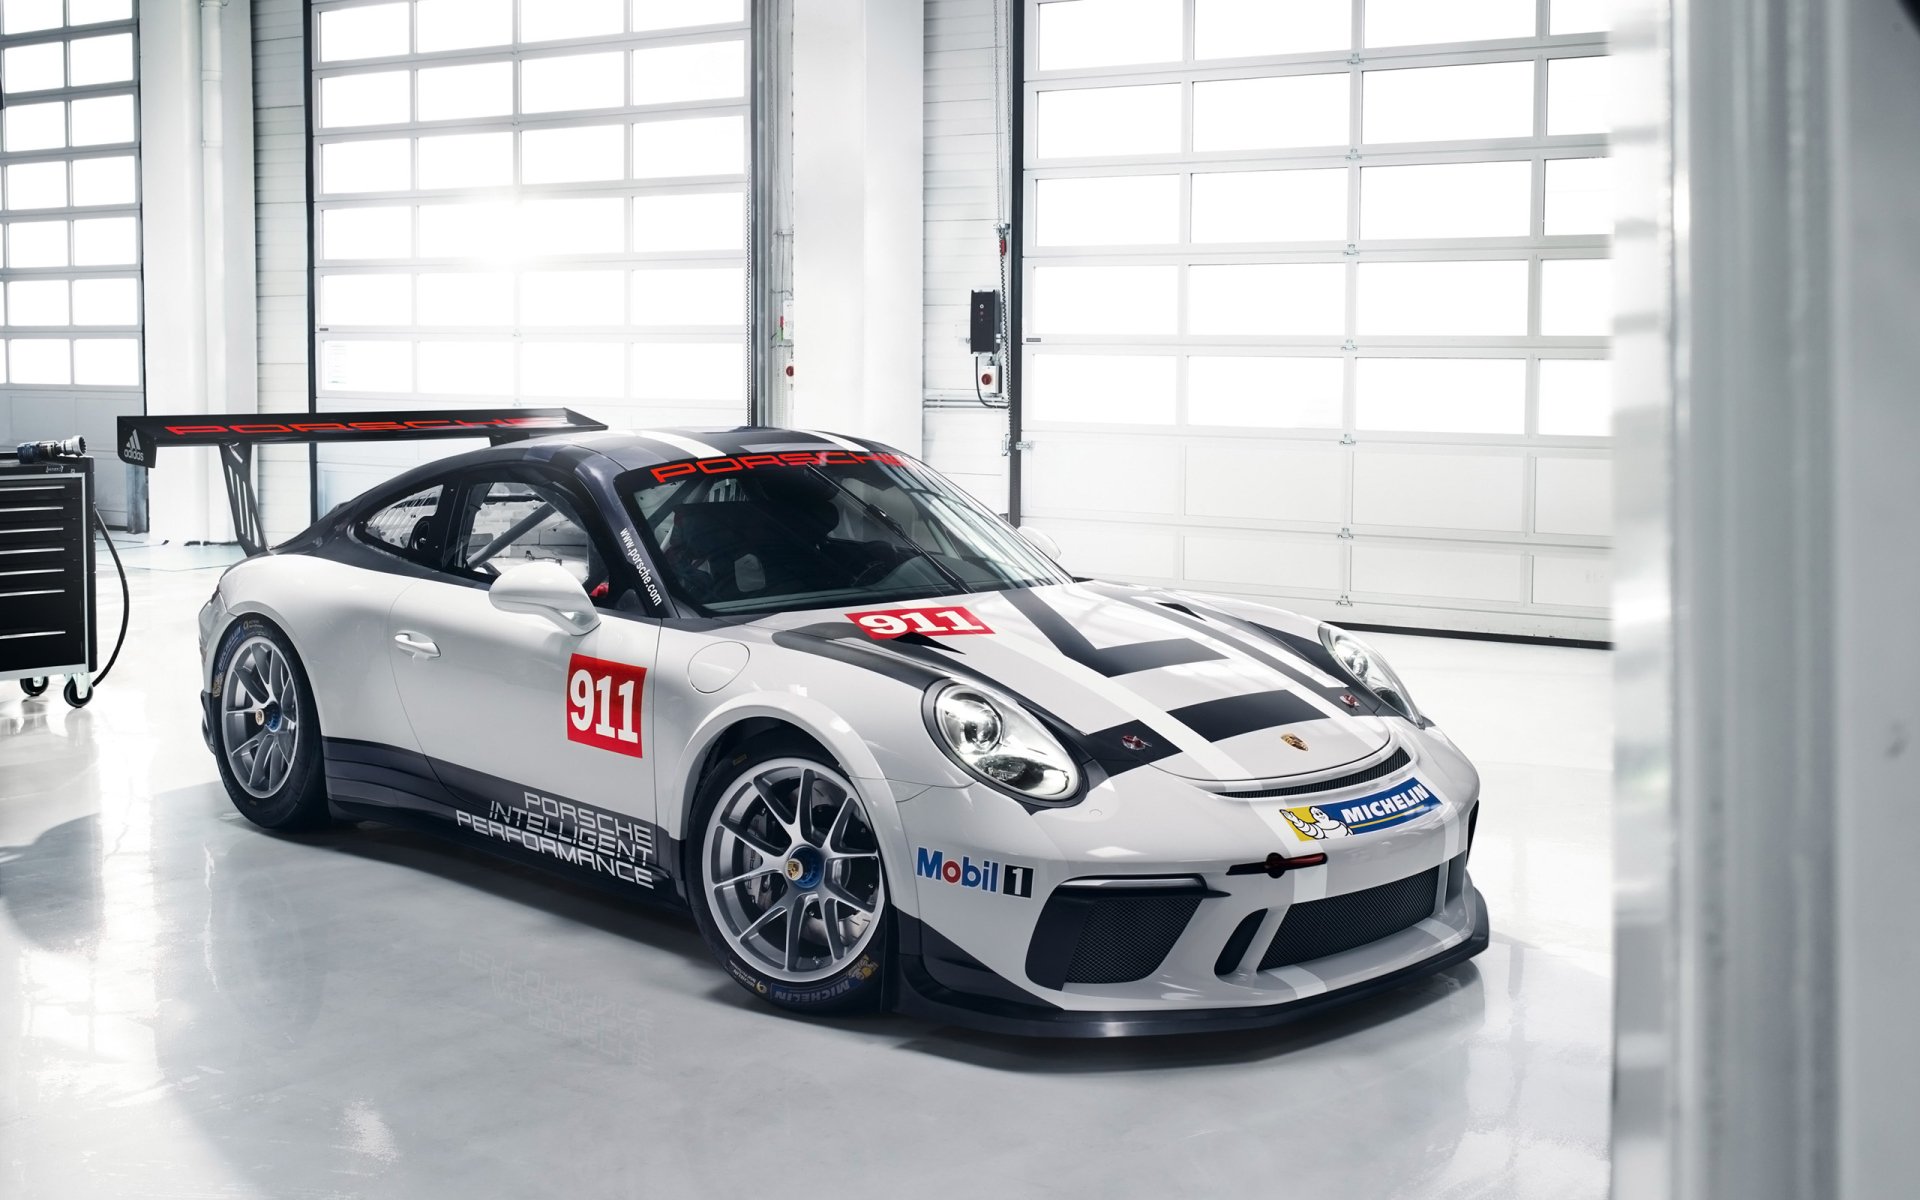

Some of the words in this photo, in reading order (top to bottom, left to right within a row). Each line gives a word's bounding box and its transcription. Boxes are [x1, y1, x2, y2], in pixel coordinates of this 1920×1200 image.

[124, 449, 144, 461] adidas
[620, 528, 662, 606] www.porsche.com
[859, 611, 985, 634] 911
[570, 669, 639, 744] 911
[524, 791, 652, 848] PORSCHE
[1341, 784, 1430, 823] MICHELIN
[456, 809, 655, 890] PERFORMANCE
[489, 800, 653, 867] INTELLIGENT
[916, 846, 998, 893] Mobil
[775, 978, 851, 1004] MICHELIN
